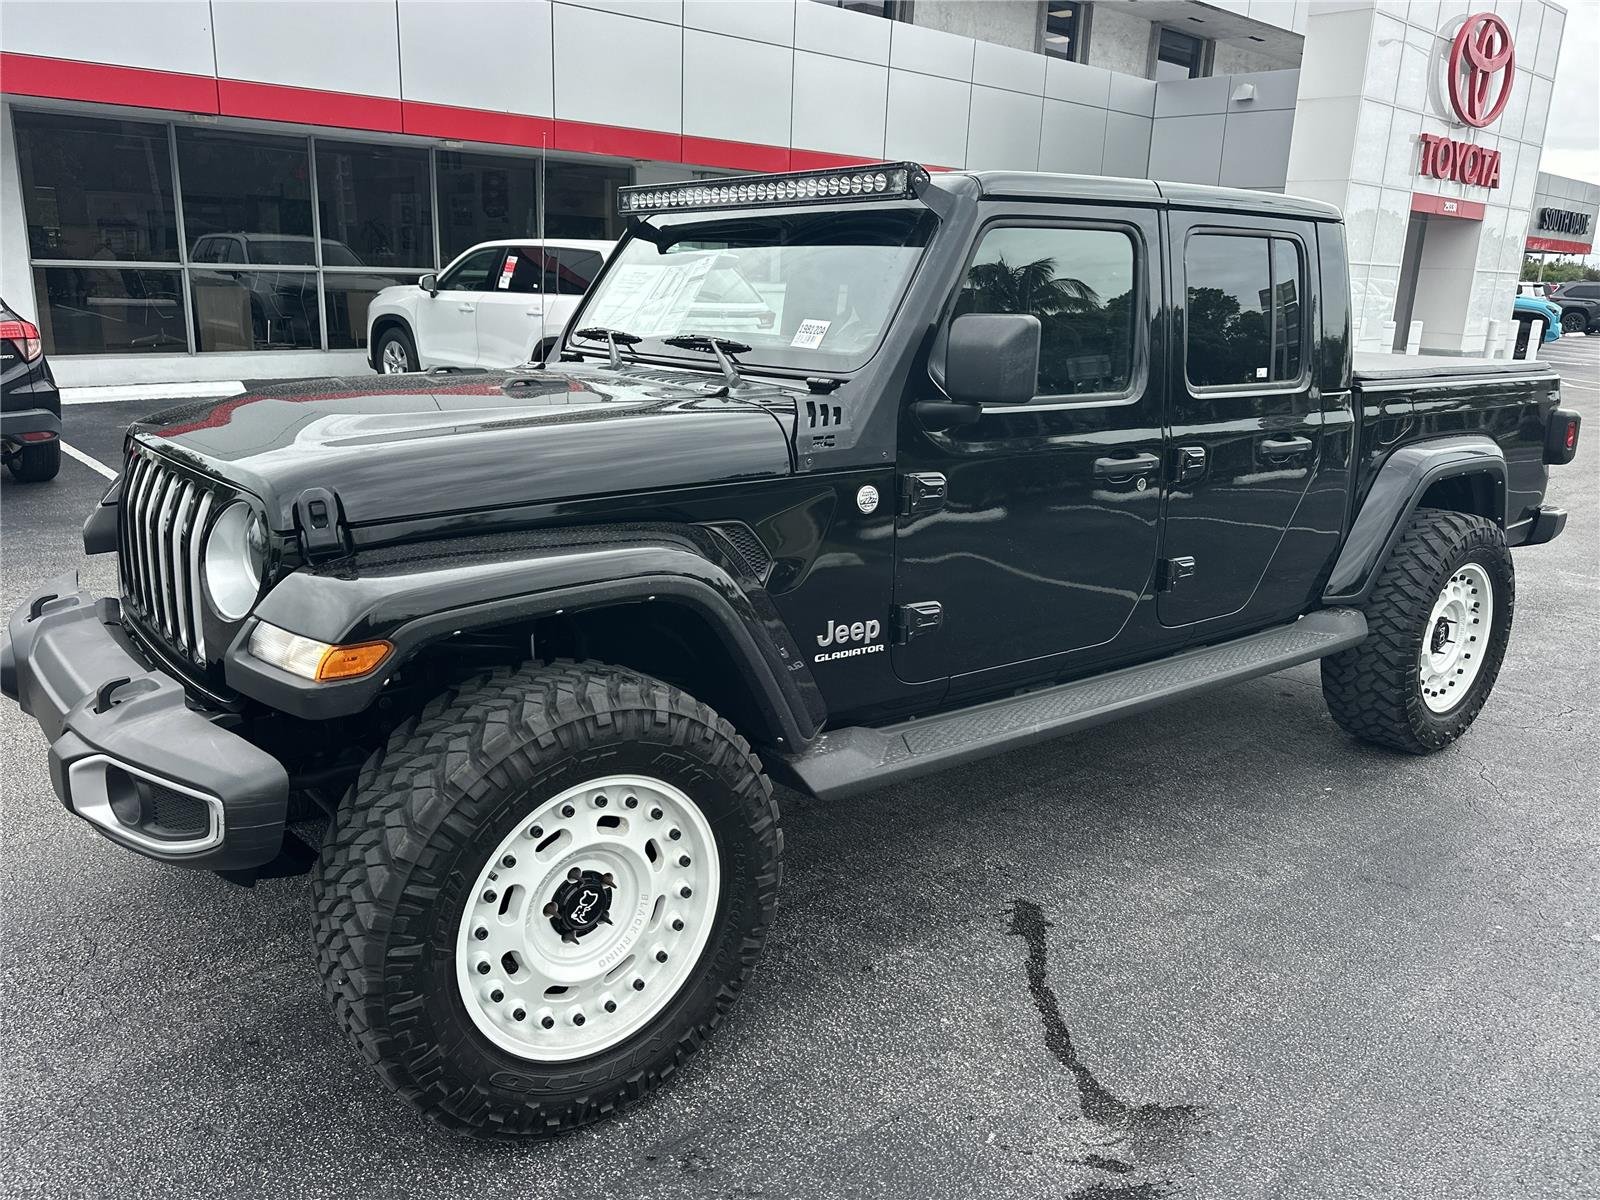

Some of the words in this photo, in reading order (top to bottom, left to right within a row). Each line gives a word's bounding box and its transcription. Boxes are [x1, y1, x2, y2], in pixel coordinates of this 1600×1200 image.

[1420, 133, 1501, 189] TOYOTA
[1541, 208, 1571, 232] SOUTH
[816, 619, 880, 647] Jeep
[814, 644, 885, 663] GLADIATOR
[630, 894, 649, 935] BLACK
[598, 936, 632, 968] RHINO
